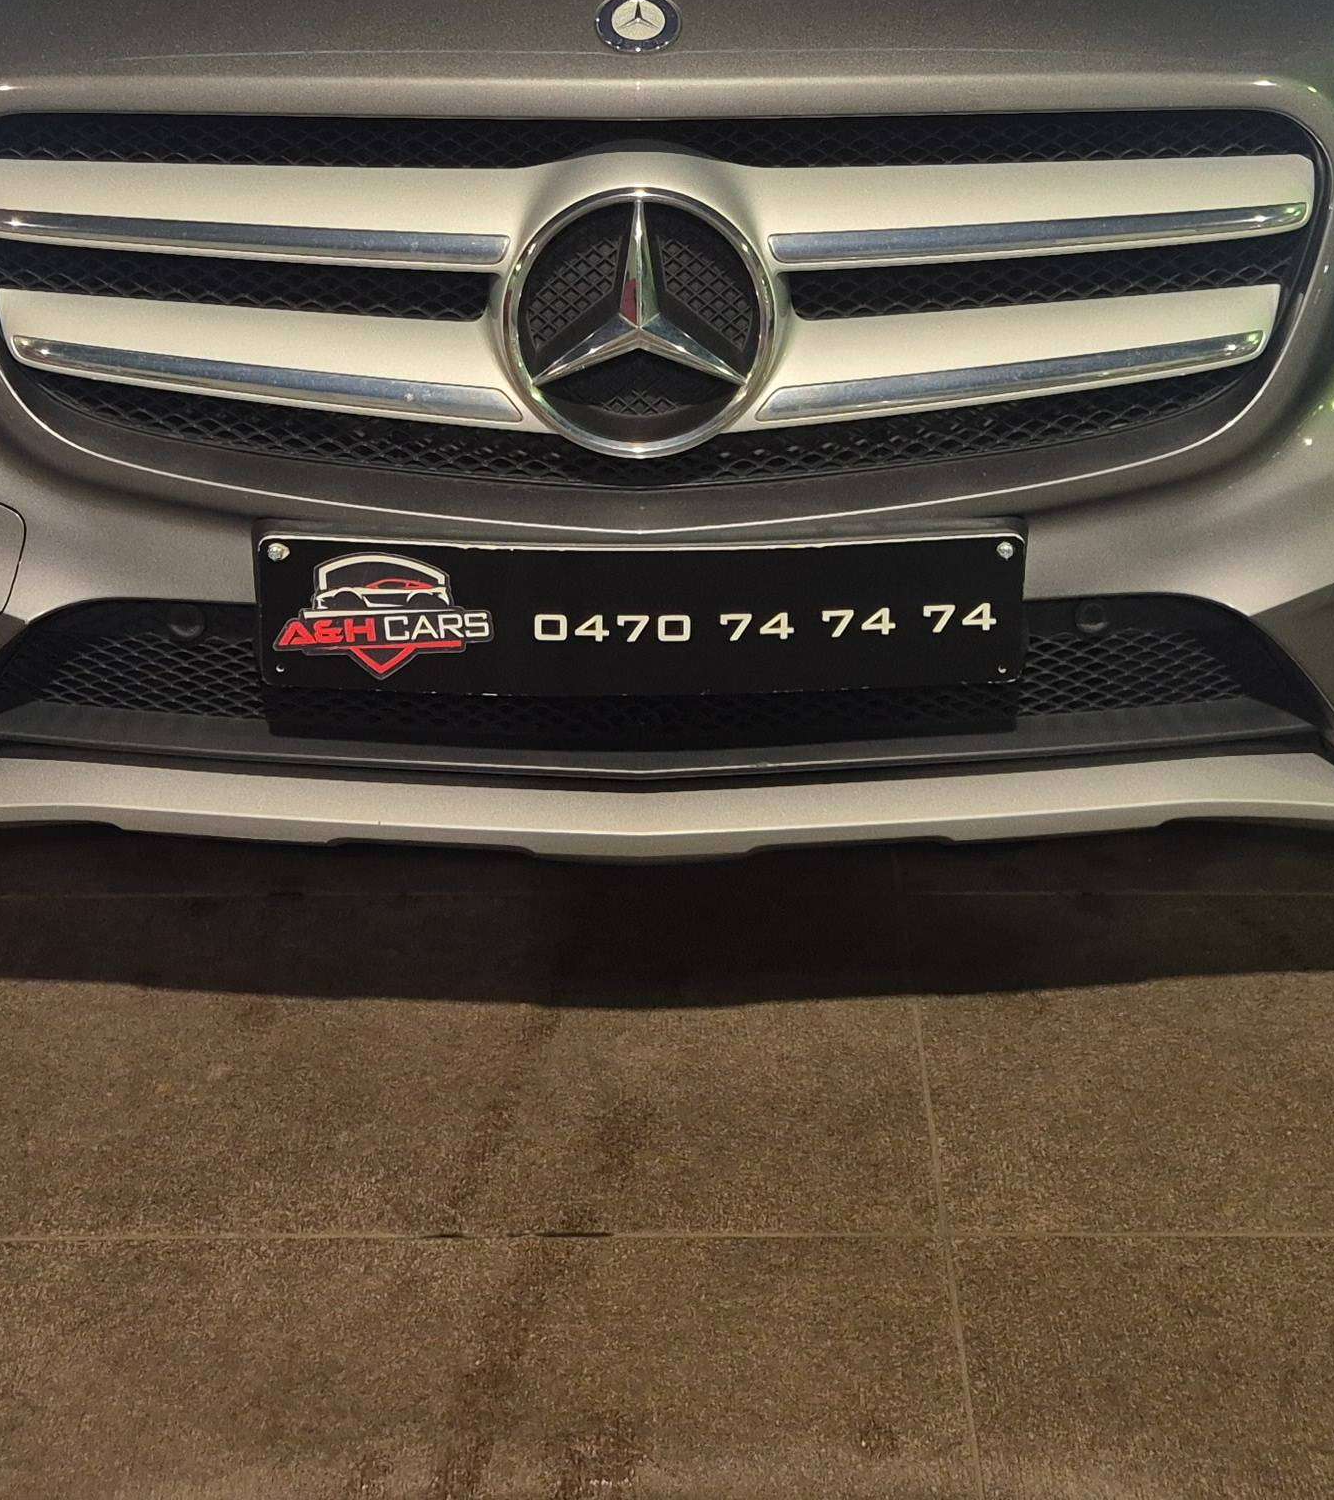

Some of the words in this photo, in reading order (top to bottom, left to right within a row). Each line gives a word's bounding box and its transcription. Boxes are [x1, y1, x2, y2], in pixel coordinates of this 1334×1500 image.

[278, 616, 377, 646] A&H
[383, 612, 491, 641] CARS
[533, 613, 691, 643] 0470
[719, 612, 795, 642] 74
[821, 607, 897, 638] 74
[922, 602, 997, 633] 74
